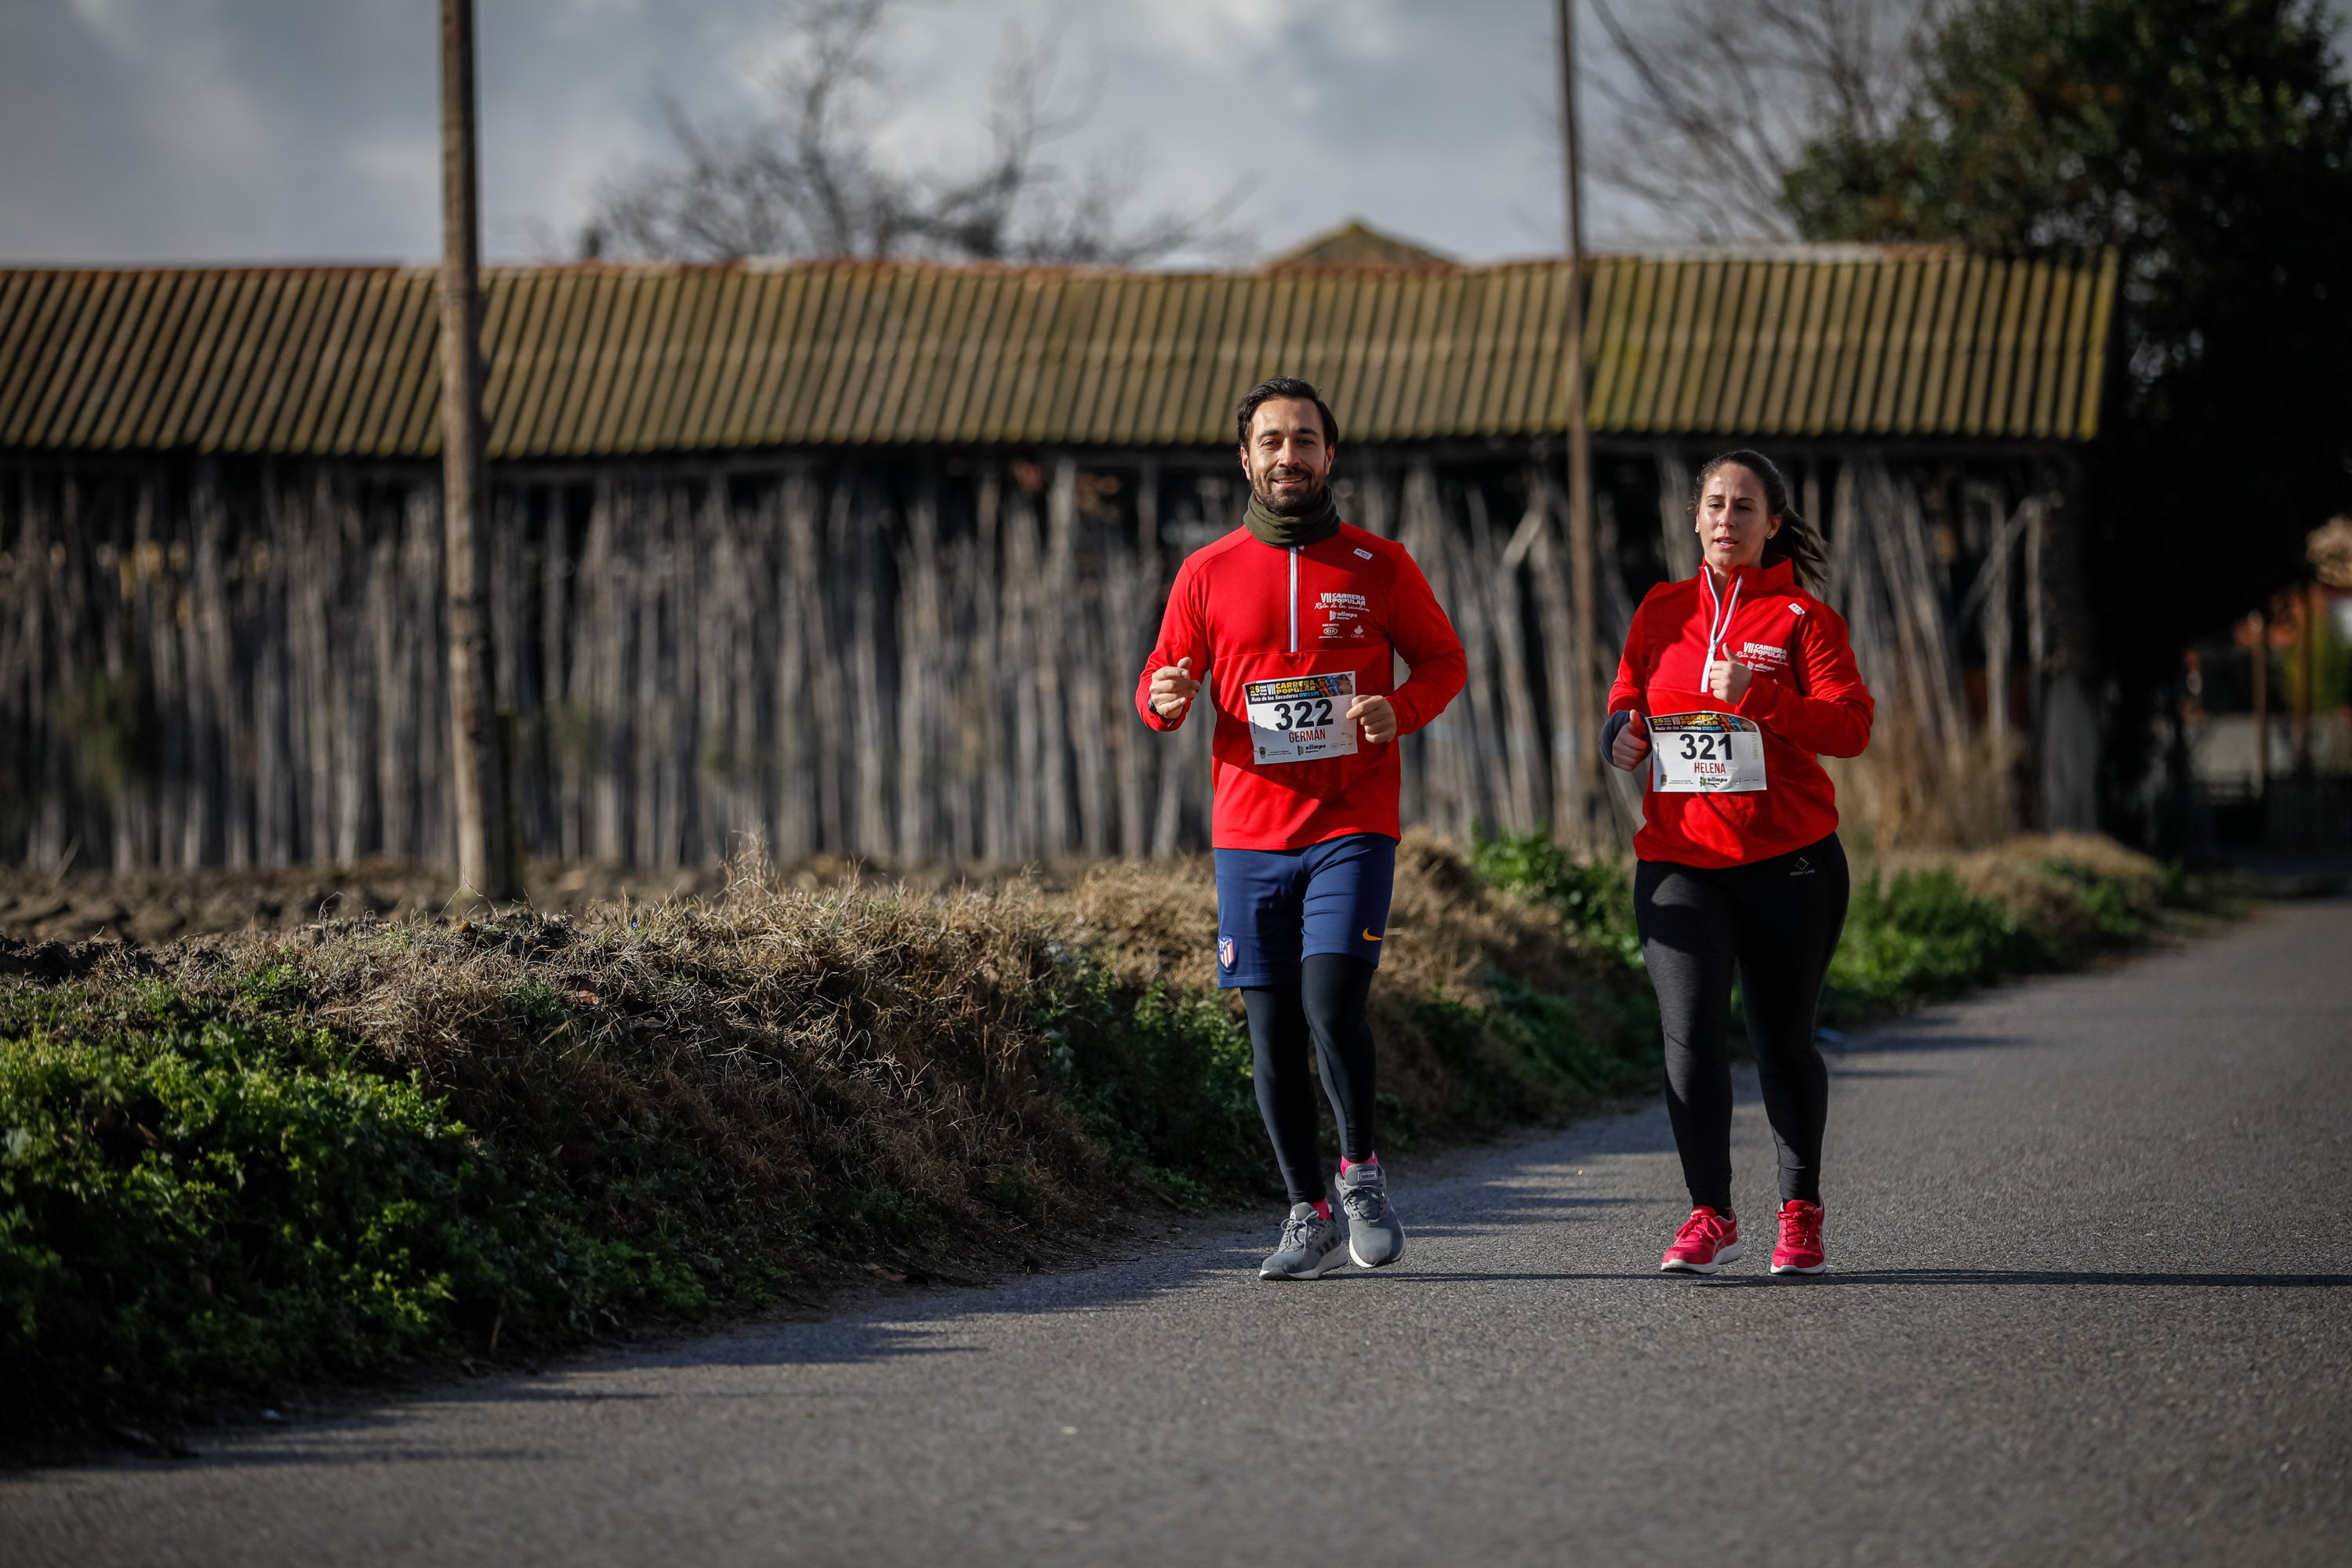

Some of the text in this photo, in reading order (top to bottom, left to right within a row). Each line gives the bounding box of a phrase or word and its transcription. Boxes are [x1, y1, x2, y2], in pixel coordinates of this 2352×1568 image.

[1320, 593, 1331, 603] VII
[1744, 642, 1755, 654] VII
[1755, 644, 1787, 655] CARRERA
[1753, 649, 1786, 659] POPULAR
[1250, 685, 1260, 694] 26
[1267, 684, 1276, 695] VII
[1276, 680, 1315, 689] CARRERA
[1276, 686, 1316, 695] POPULAR
[1274, 699, 1334, 731] 322
[1671, 716, 1681, 725] VII
[1289, 727, 1326, 743] GERMÁN
[1679, 734, 1733, 760] 321
[1694, 762, 1726, 774] HELENA
